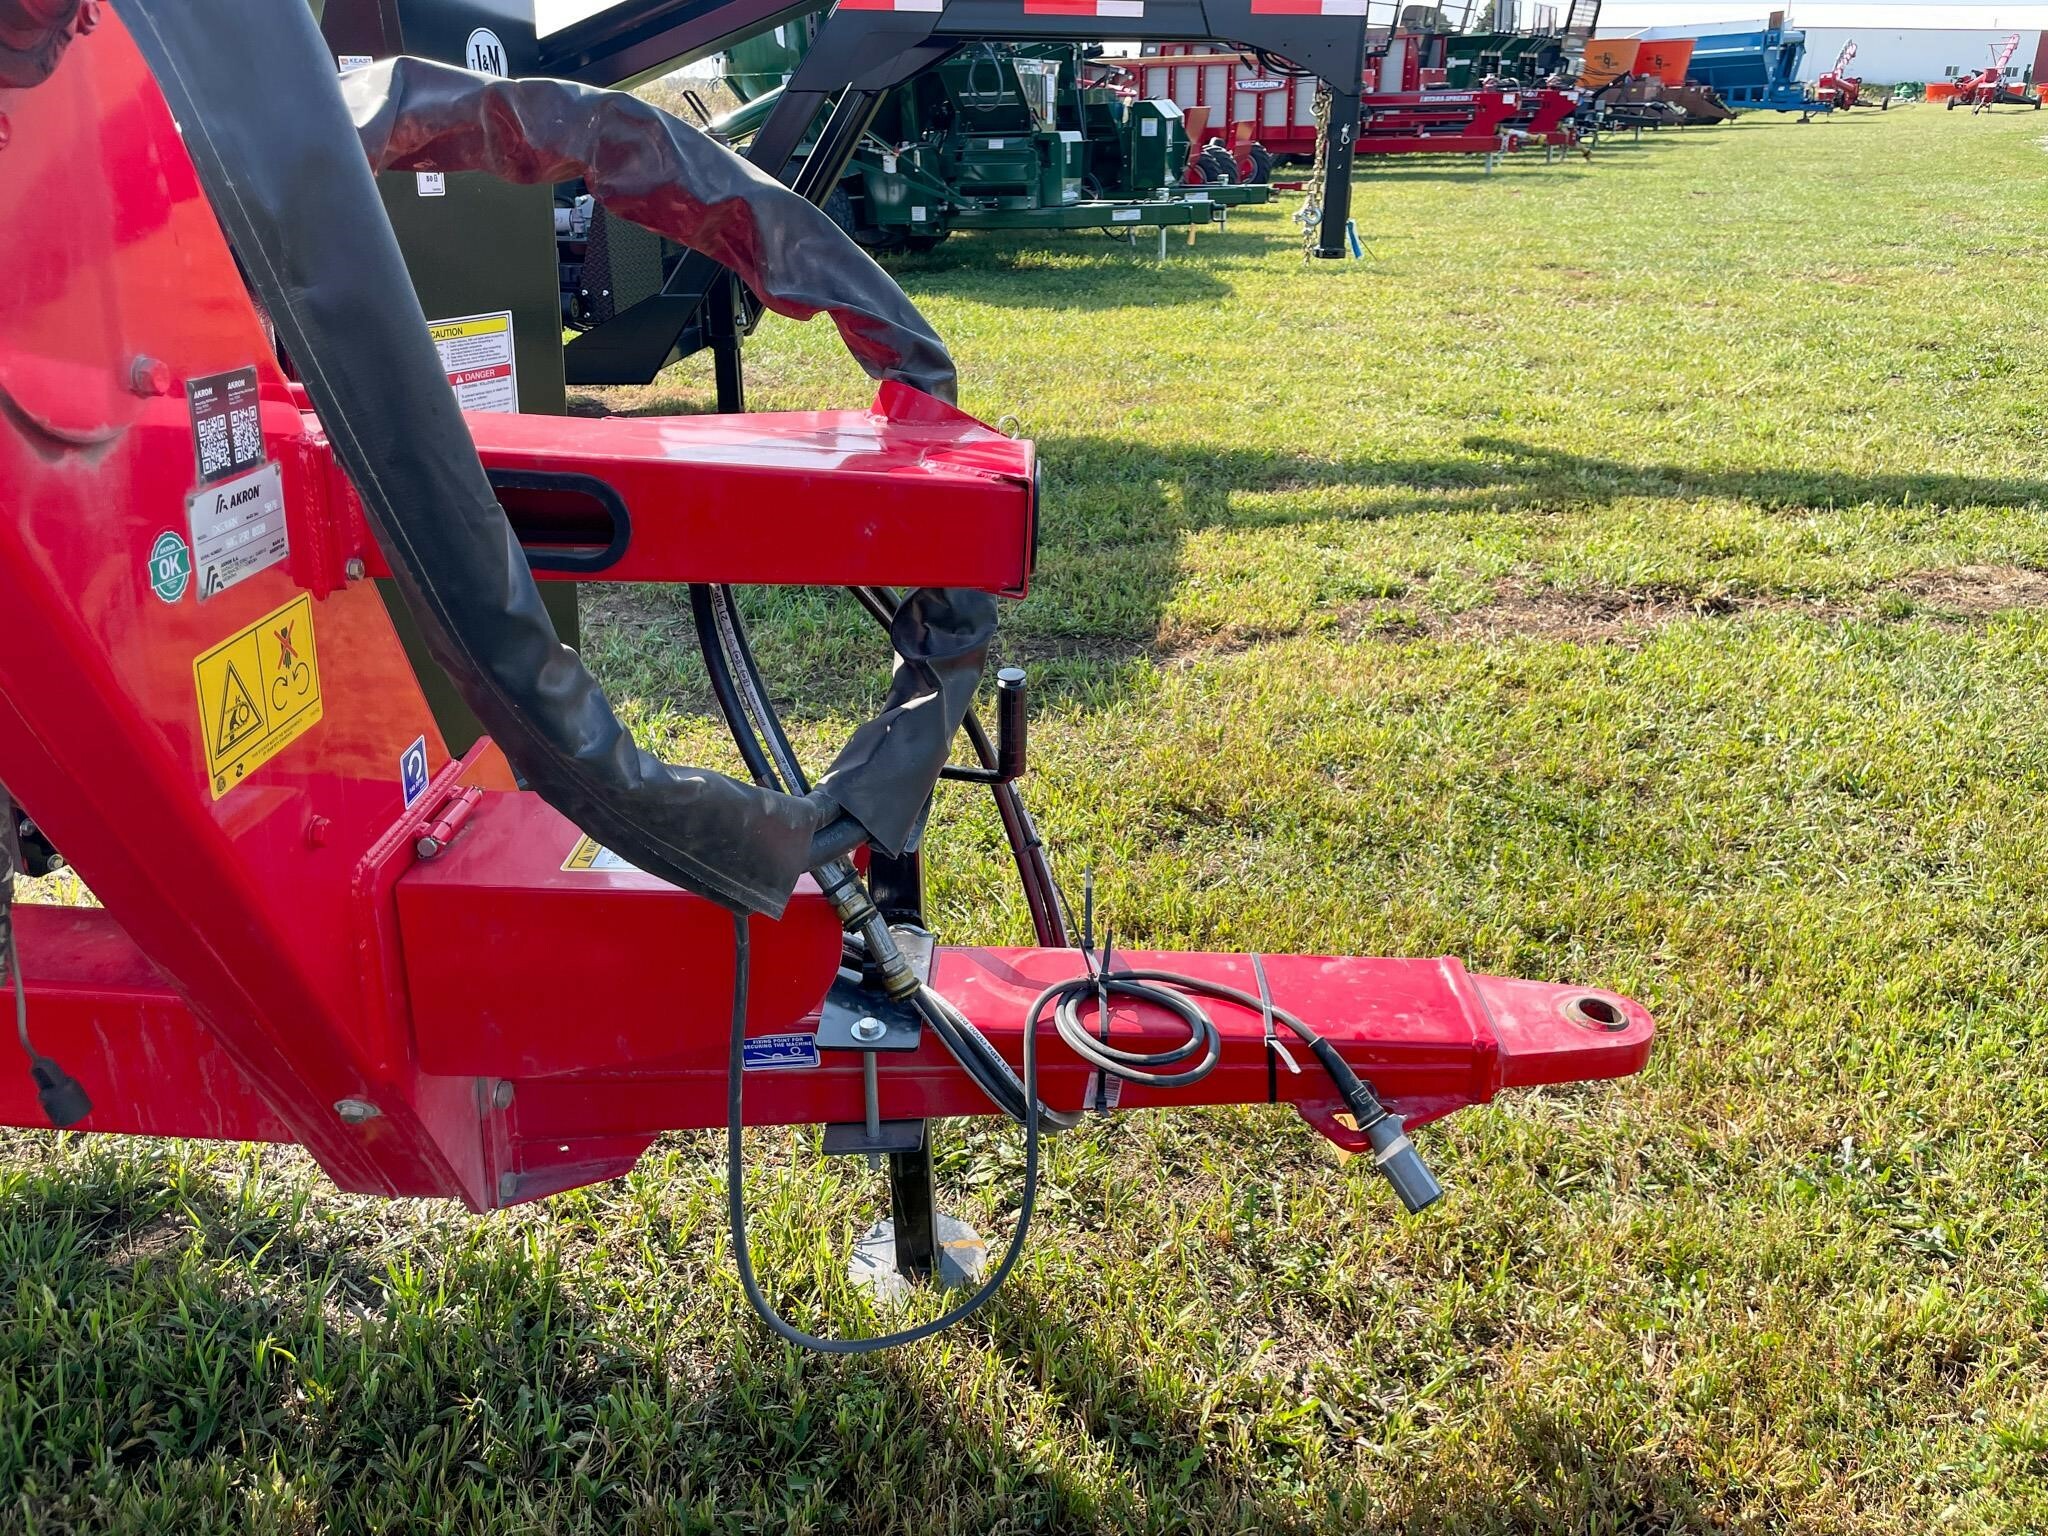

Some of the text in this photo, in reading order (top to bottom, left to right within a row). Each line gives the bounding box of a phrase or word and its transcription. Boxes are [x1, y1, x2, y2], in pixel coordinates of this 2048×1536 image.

[431, 327, 463, 339] CAUTION
[465, 369, 495, 381] DANGER
[227, 379, 246, 390] AKRON
[193, 387, 213, 399] AKRON
[229, 484, 261, 509] AKRON
[159, 553, 182, 580] OK
[1000, 1062, 1010, 1072] 21
